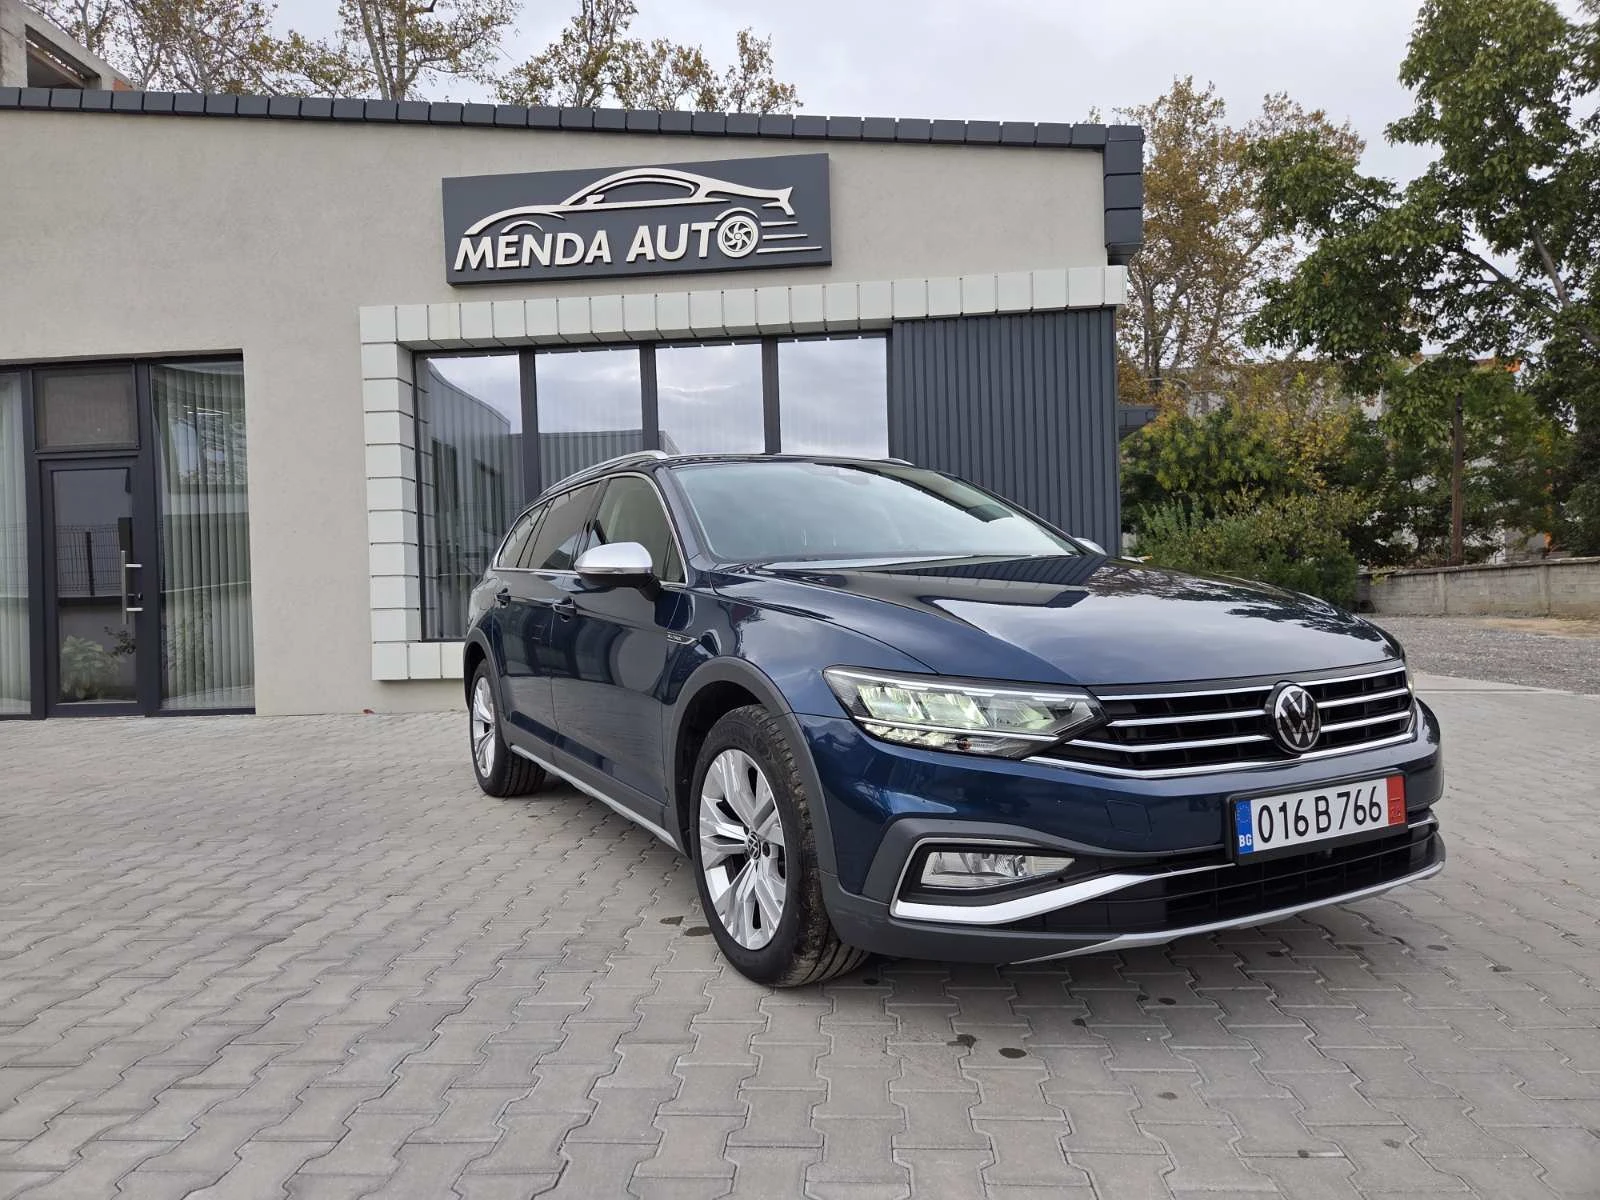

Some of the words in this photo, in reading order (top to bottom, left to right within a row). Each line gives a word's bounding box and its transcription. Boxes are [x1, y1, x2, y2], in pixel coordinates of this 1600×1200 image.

[453, 229, 612, 271] MENDA
[626, 215, 760, 263] AUTO
[1239, 834, 1253, 848] BG
